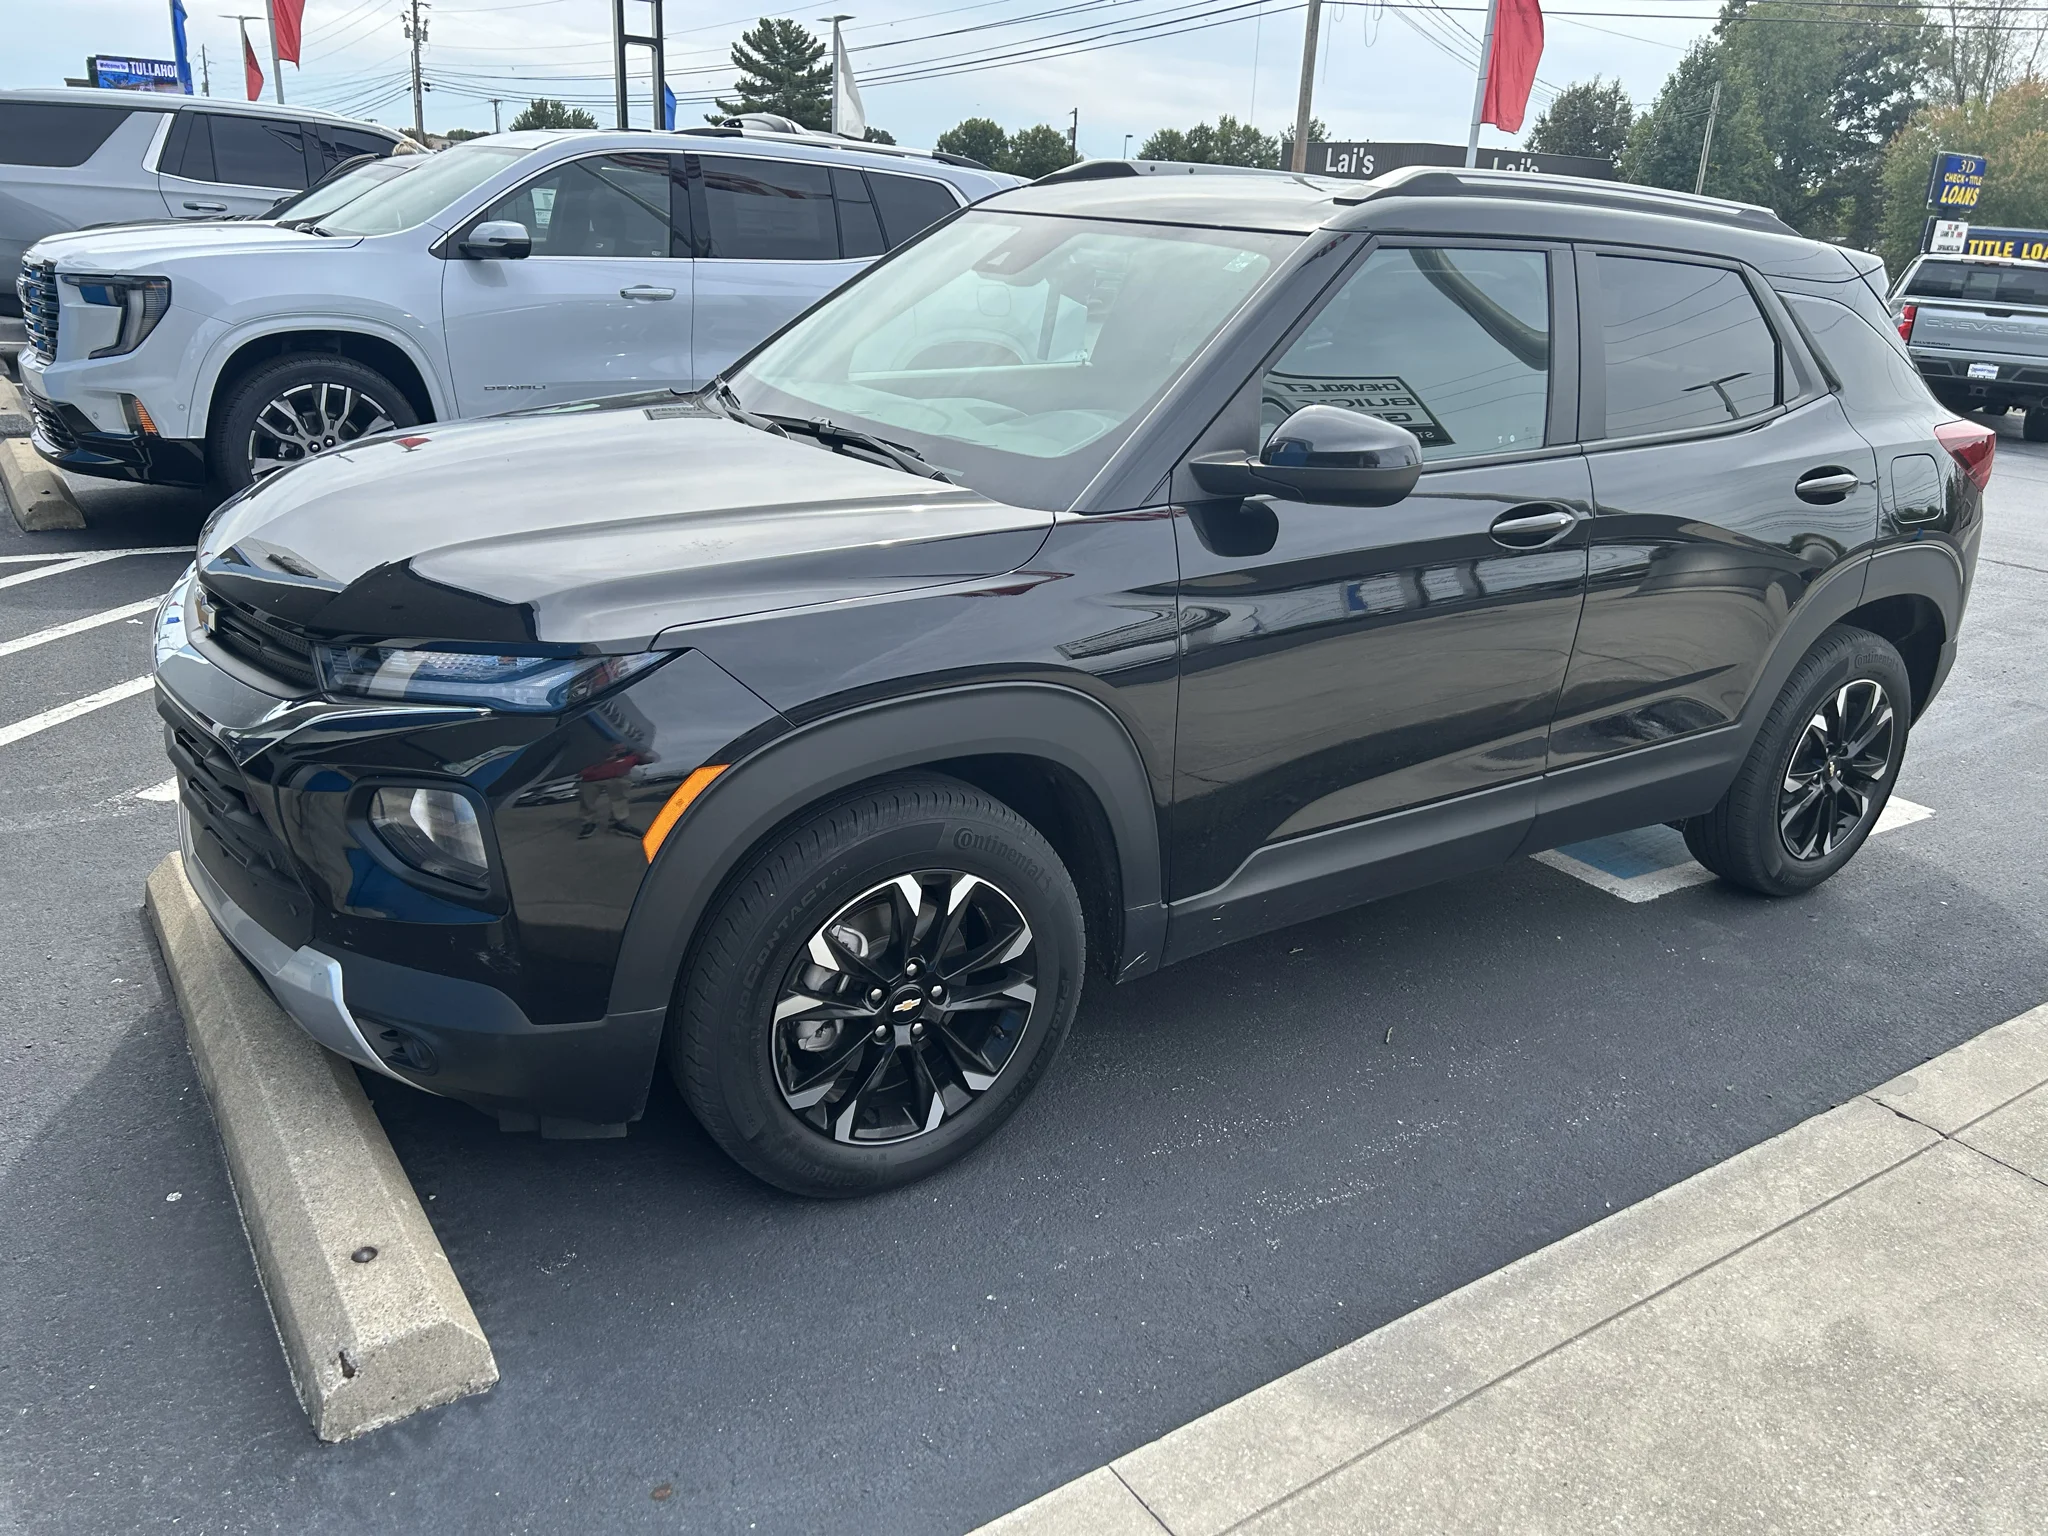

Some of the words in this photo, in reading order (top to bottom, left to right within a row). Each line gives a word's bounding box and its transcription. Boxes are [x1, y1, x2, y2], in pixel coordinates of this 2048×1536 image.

[1325, 147, 1375, 175] Lai's
[1957, 159, 1976, 173] 3D
[1944, 173, 1965, 184] CHECK
[1969, 175, 1983, 186] TITLE
[1940, 185, 1980, 206] LOANS
[1968, 239, 2015, 258] TITLE
[953, 827, 1046, 884] Continental
